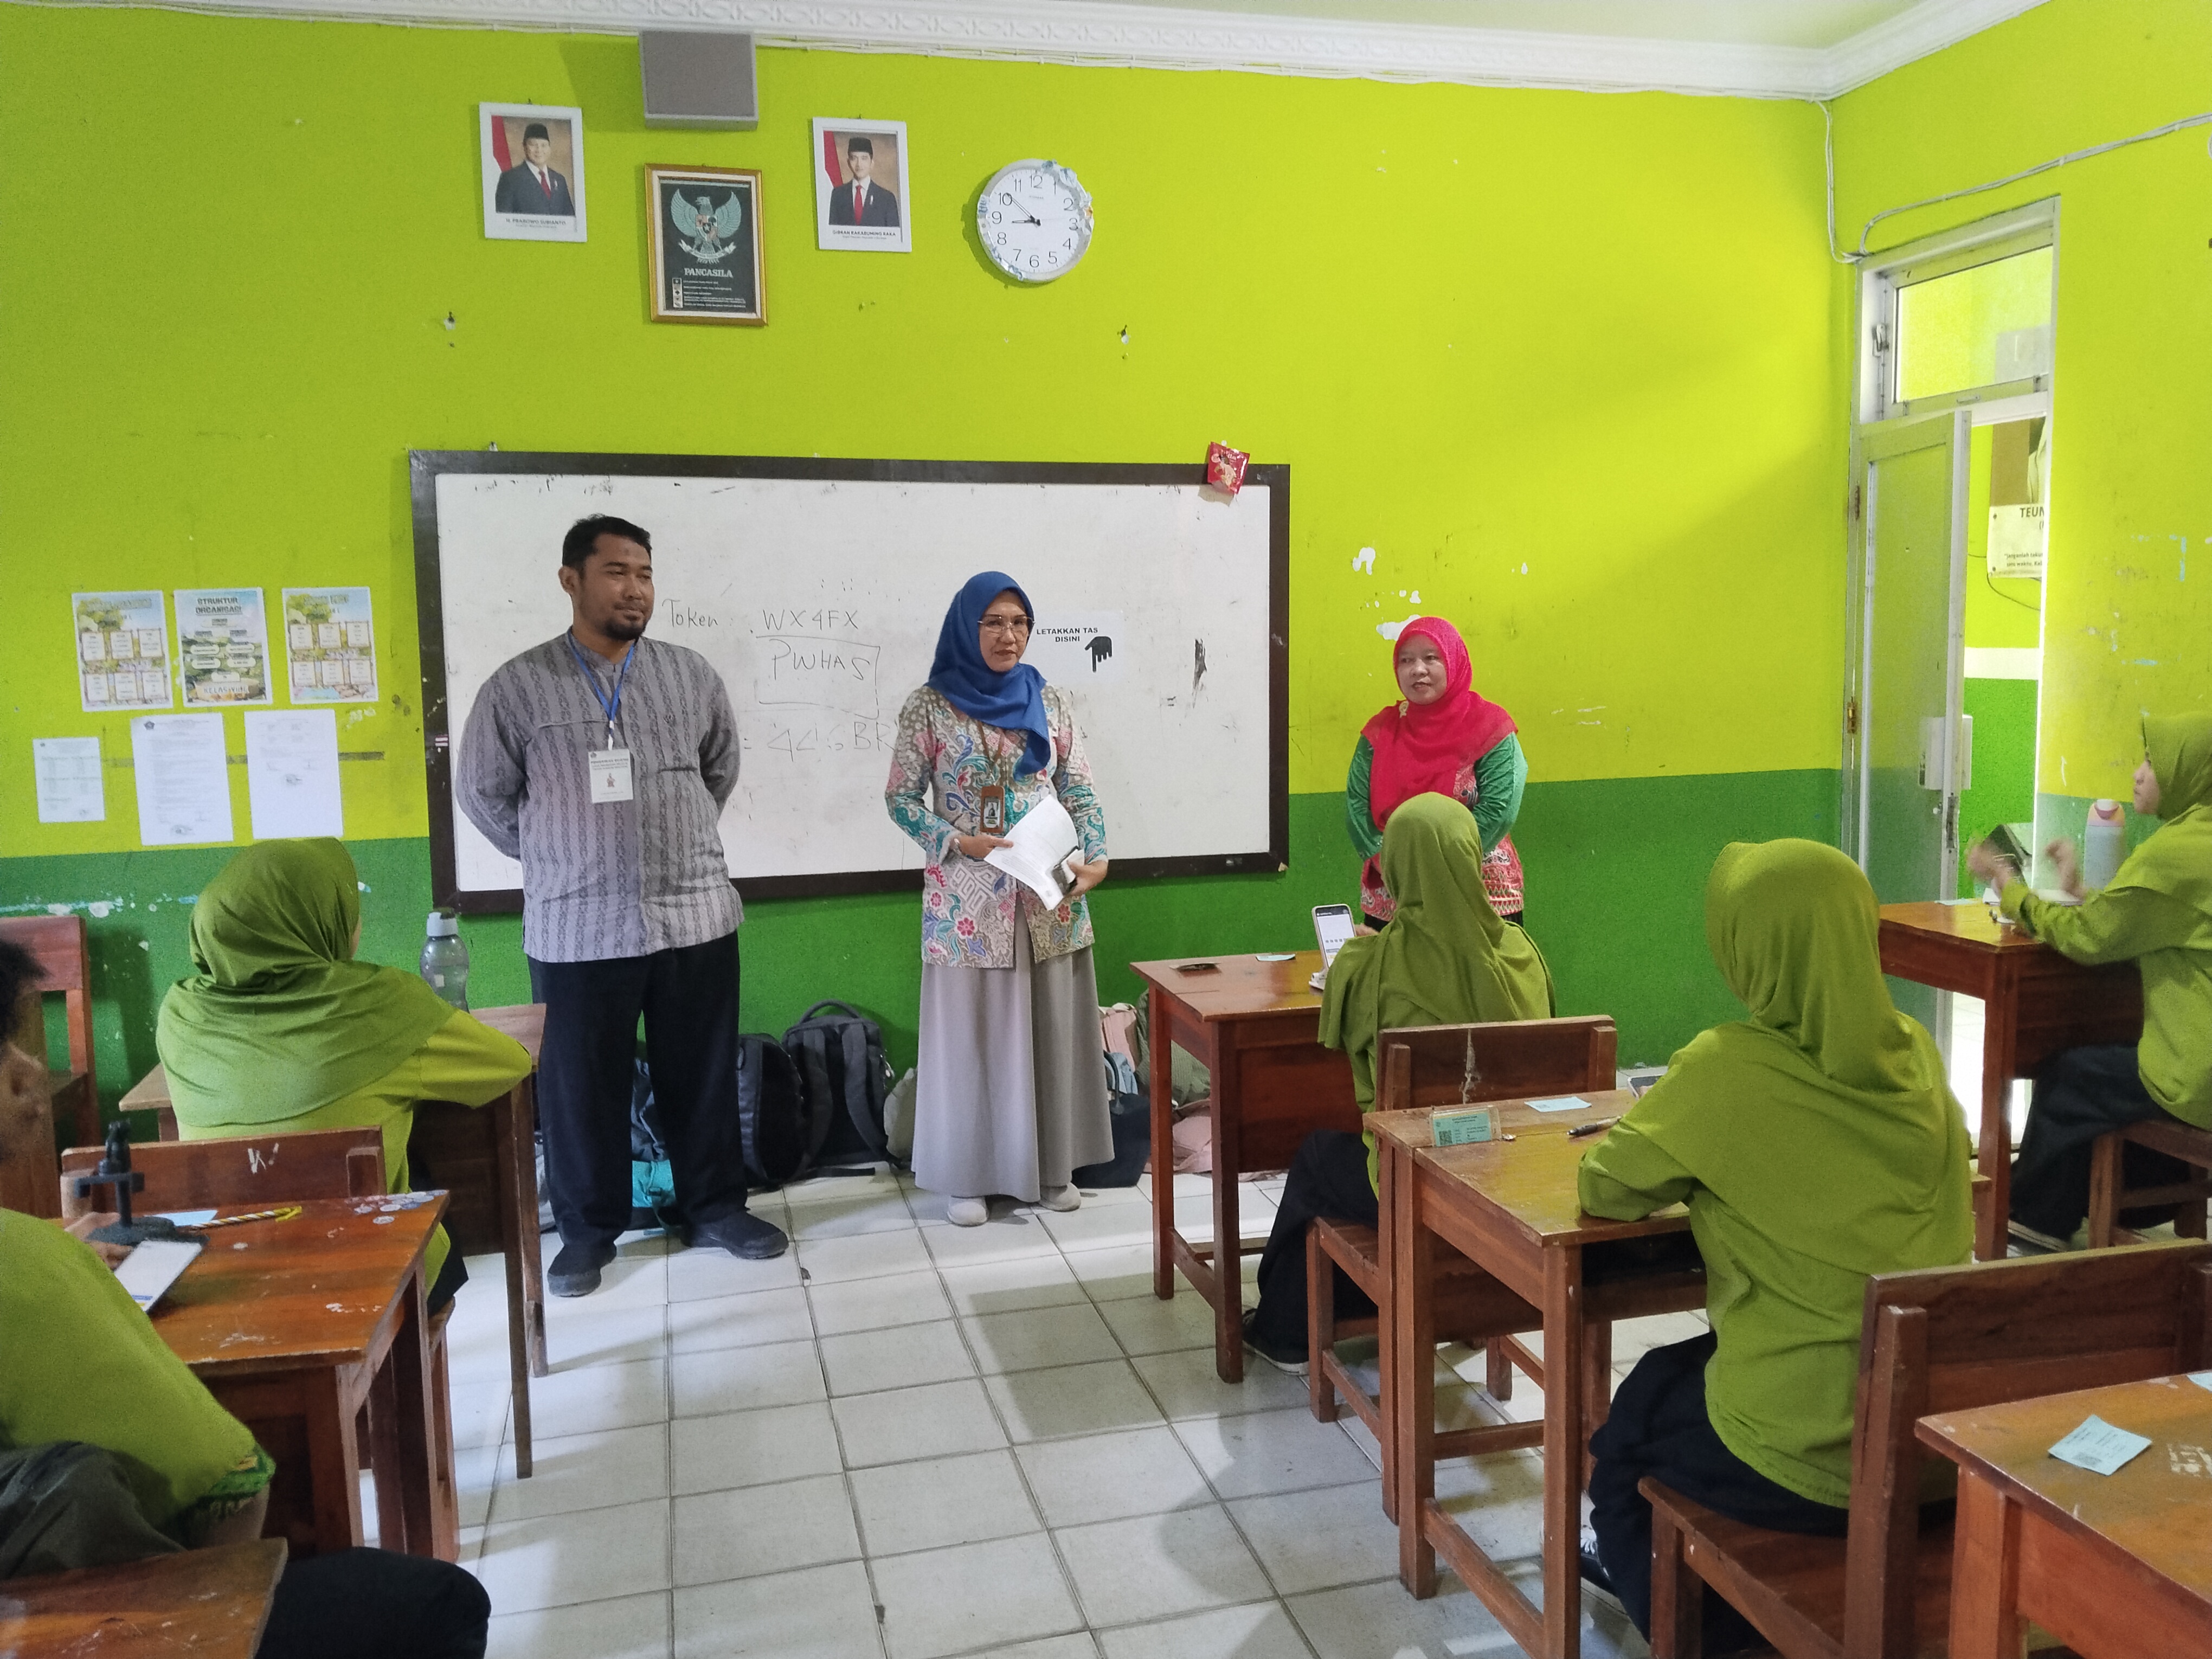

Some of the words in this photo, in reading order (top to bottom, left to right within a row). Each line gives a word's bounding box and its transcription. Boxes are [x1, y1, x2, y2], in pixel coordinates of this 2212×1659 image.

[1014, 178, 1022, 192] 11
[1029, 174, 1043, 189] 12
[1063, 197, 1074, 211] 2
[992, 211, 1002, 224] 9
[1069, 217, 1078, 231] 3
[997, 232, 1007, 246] 8
[1062, 237, 1072, 250] 4
[1013, 248, 1022, 262] 7
[1029, 254, 1040, 268] 6
[1047, 251, 1057, 264] 5
[684, 267, 734, 278] PANCASILA
[197, 597, 239, 605] STRUKTUR
[195, 606, 242, 614] ORGANISASI
[661, 598, 718, 629] Token
